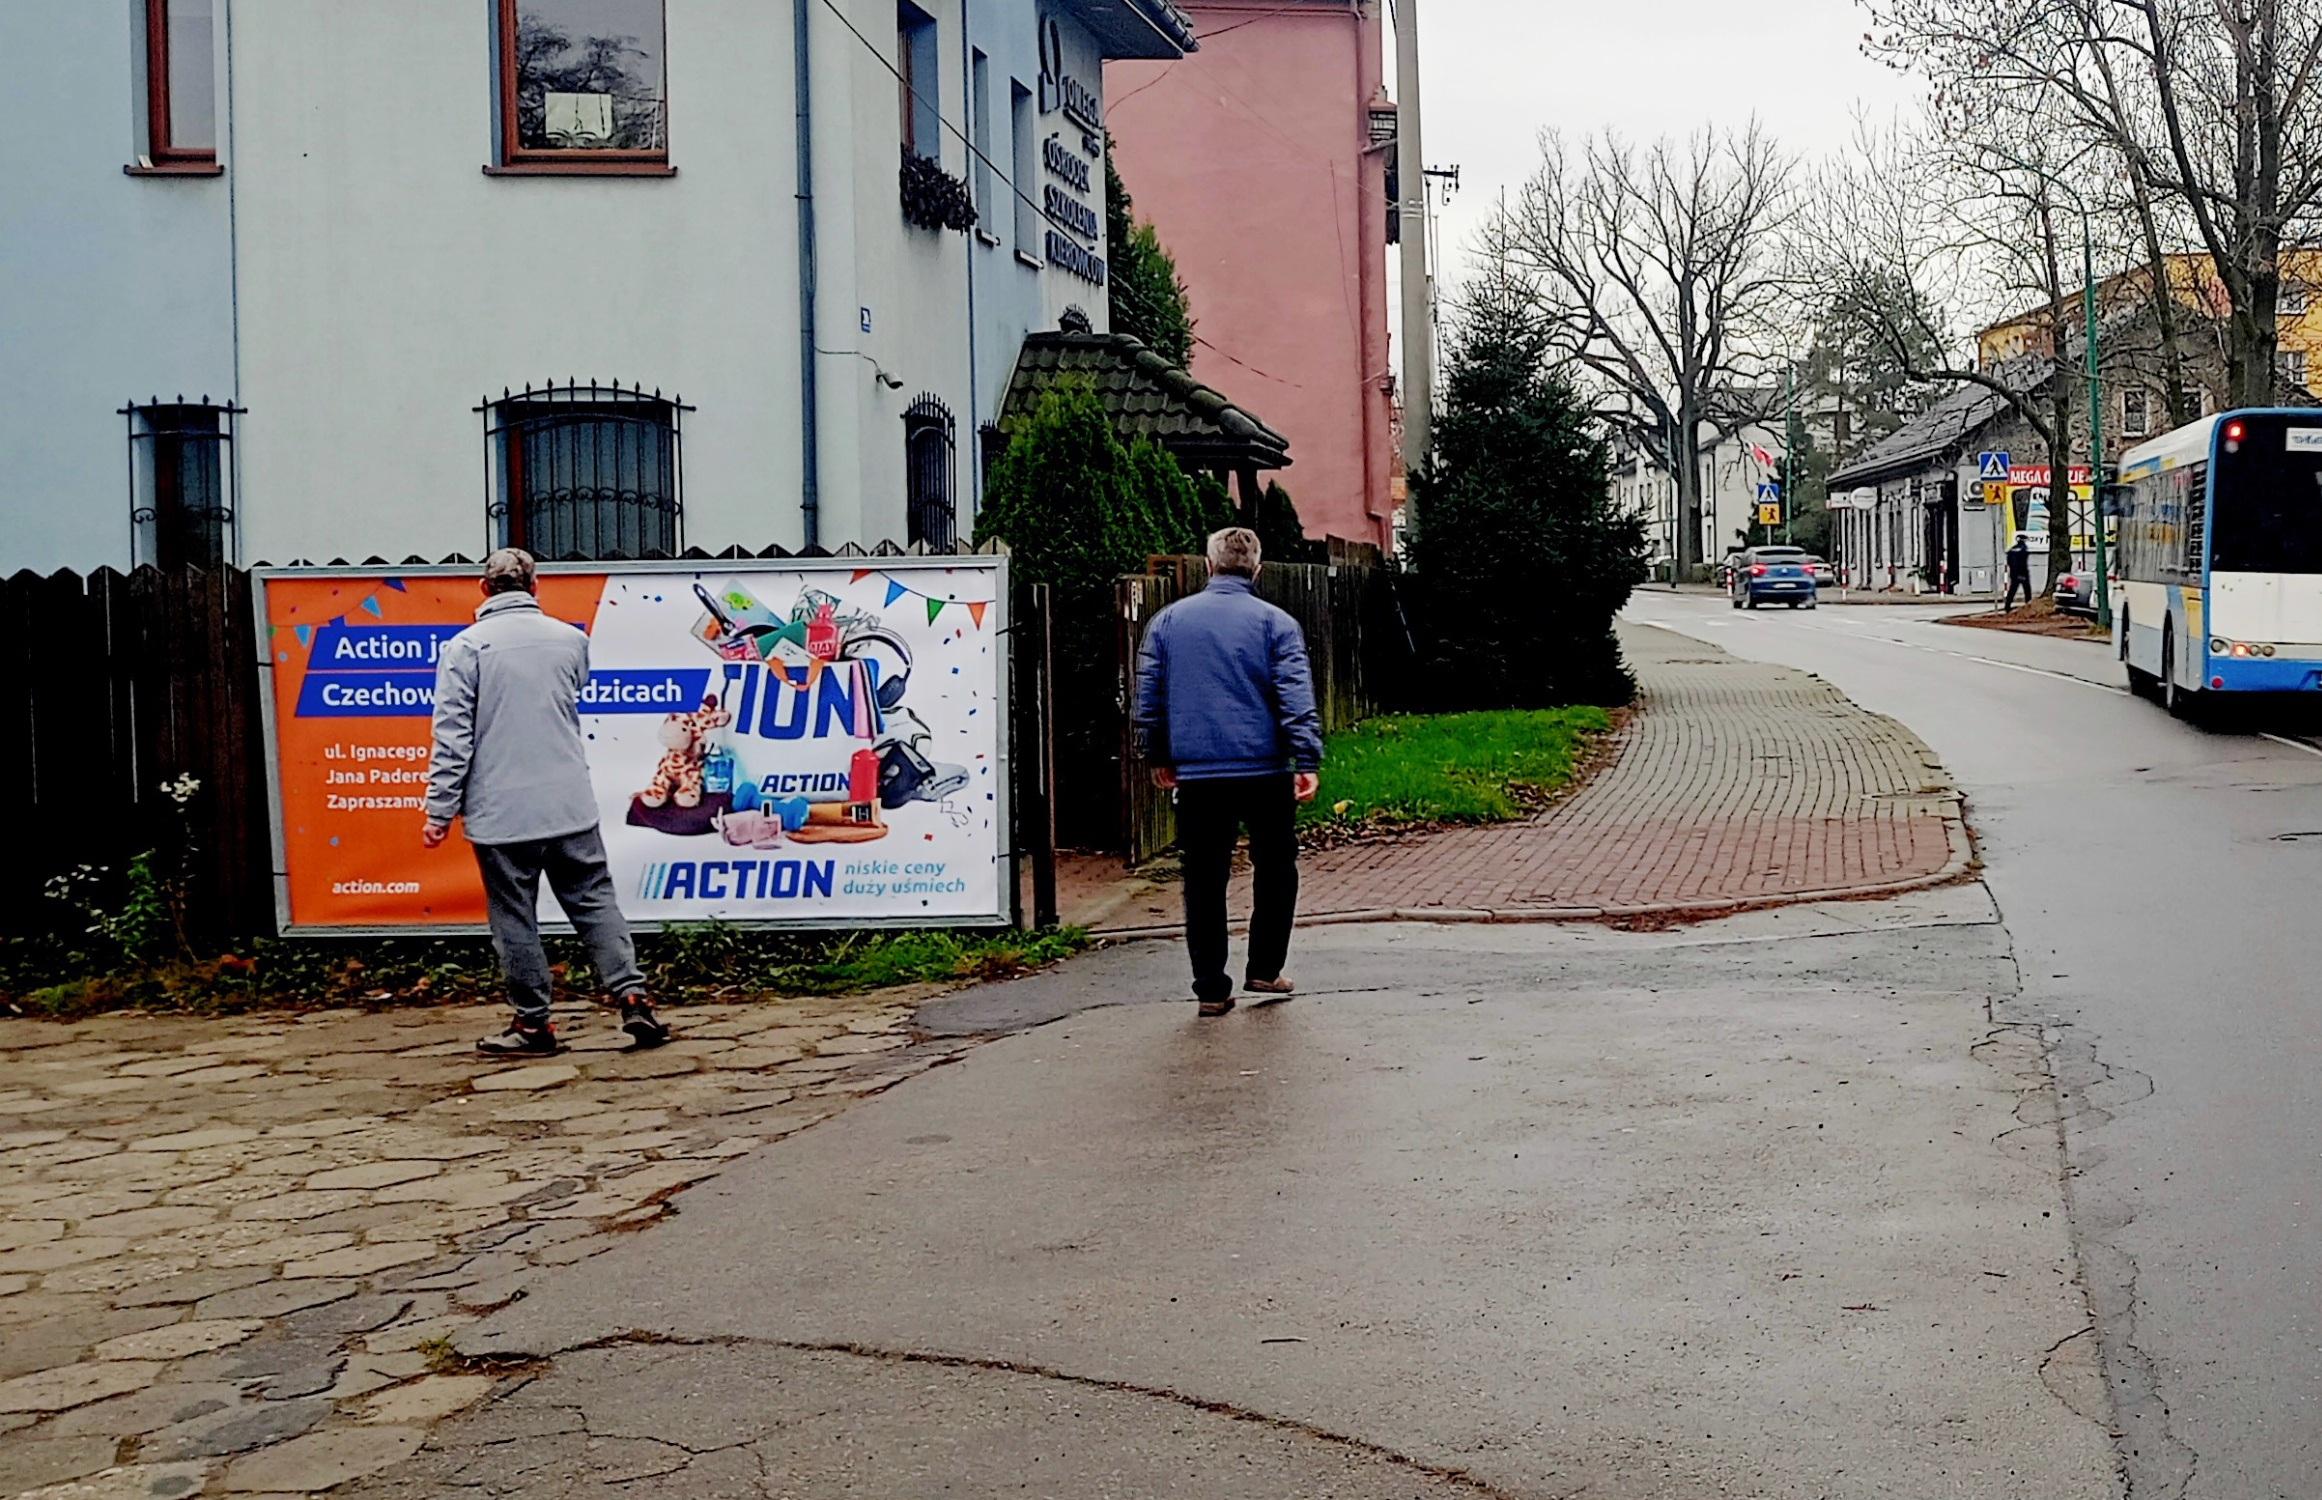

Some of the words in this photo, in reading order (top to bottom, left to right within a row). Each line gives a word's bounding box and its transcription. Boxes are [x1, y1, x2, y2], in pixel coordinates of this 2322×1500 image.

[2010, 470, 2042, 484] MEGA
[335, 634, 422, 659] Action
[322, 681, 436, 706] Czechow
[324, 743, 346, 759] ul.
[351, 744, 428, 762] Ignacego
[326, 769, 365, 784] Jana
[370, 768, 430, 784] Padere
[760, 772, 851, 793] ACTION
[844, 860, 900, 875] niskie
[904, 862, 947, 879] ceny
[332, 878, 420, 894] action.com
[663, 860, 835, 900] ACTION
[843, 878, 885, 896] duży
[892, 877, 965, 894] uśmiech
